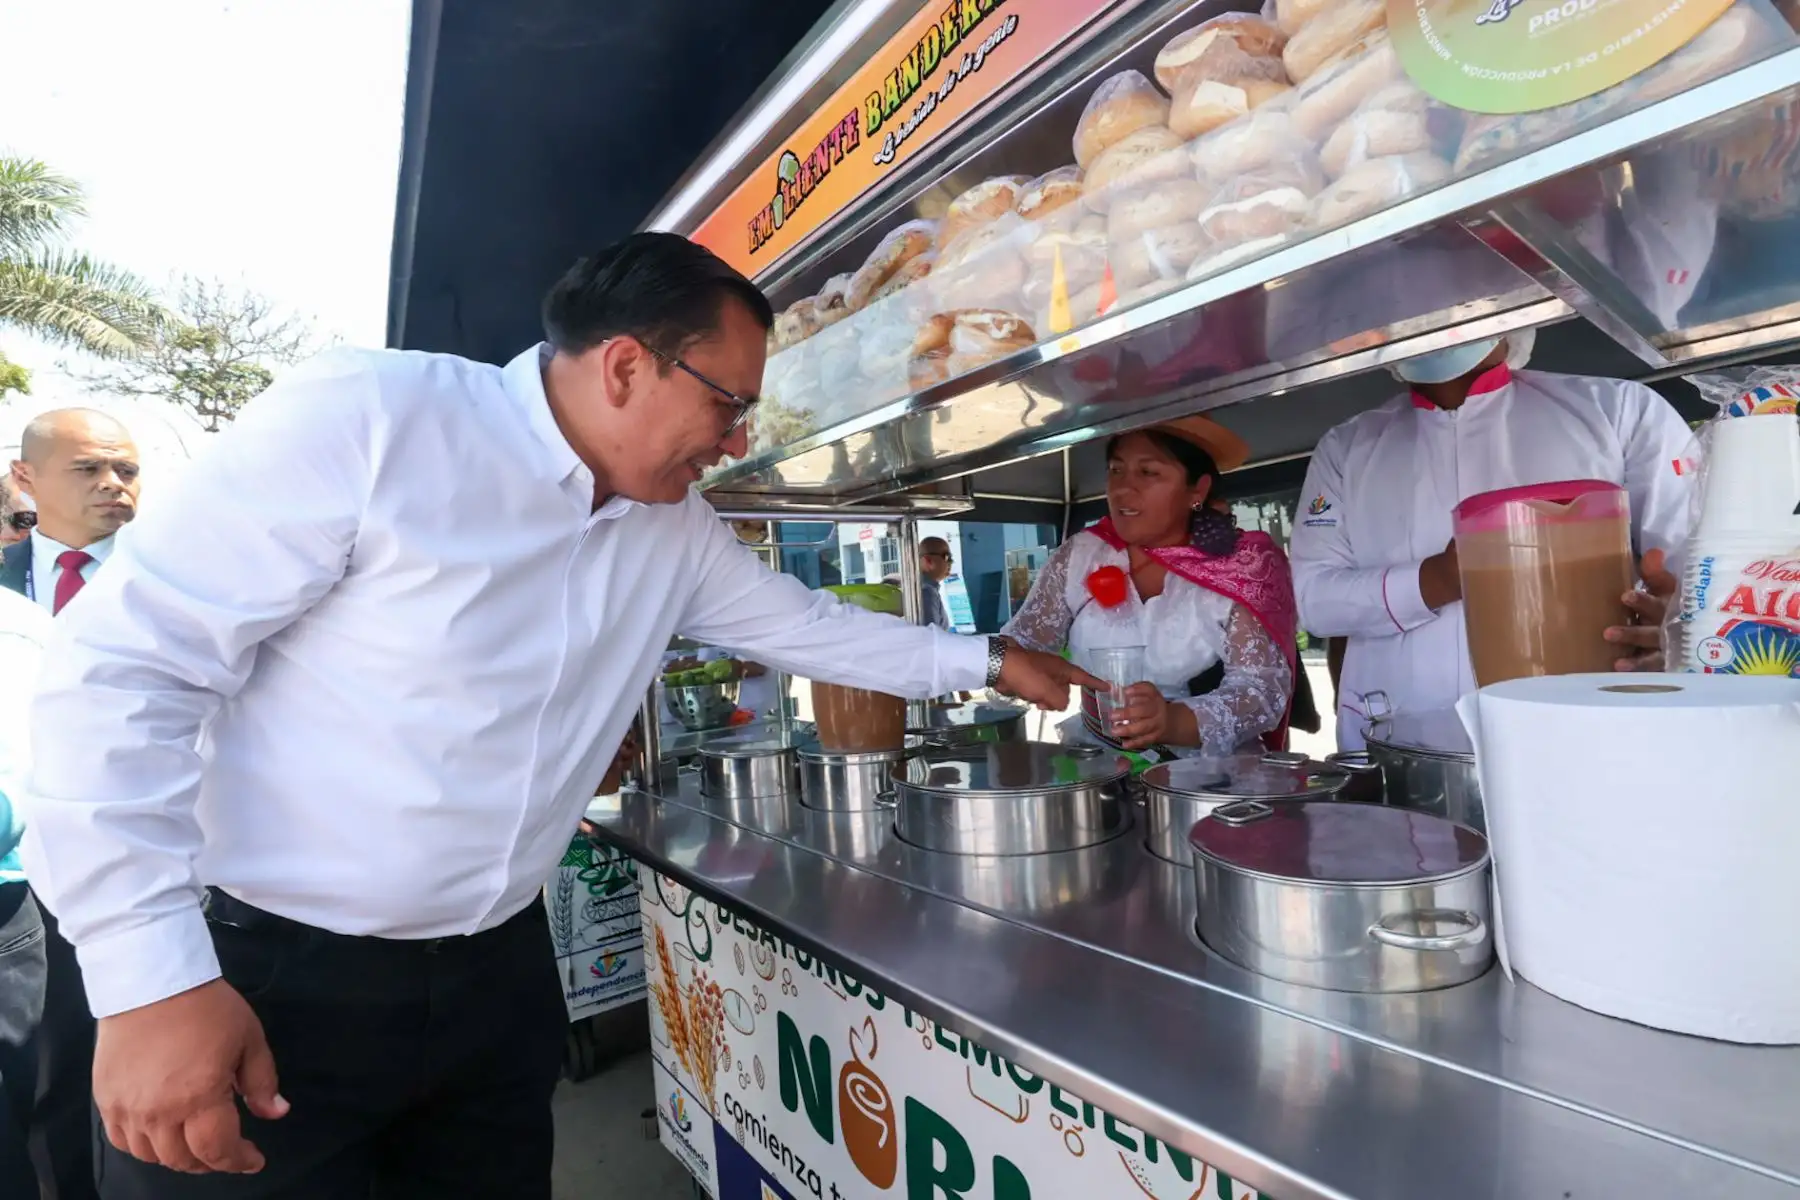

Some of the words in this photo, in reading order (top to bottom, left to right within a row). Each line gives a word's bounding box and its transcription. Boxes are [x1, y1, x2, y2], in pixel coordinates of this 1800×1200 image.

[938, 70, 957, 102] de
[957, 53, 976, 82] la
[973, 15, 1019, 72] gente
[1552, 62, 1572, 75] LA
[724, 1092, 822, 1200] comienza
